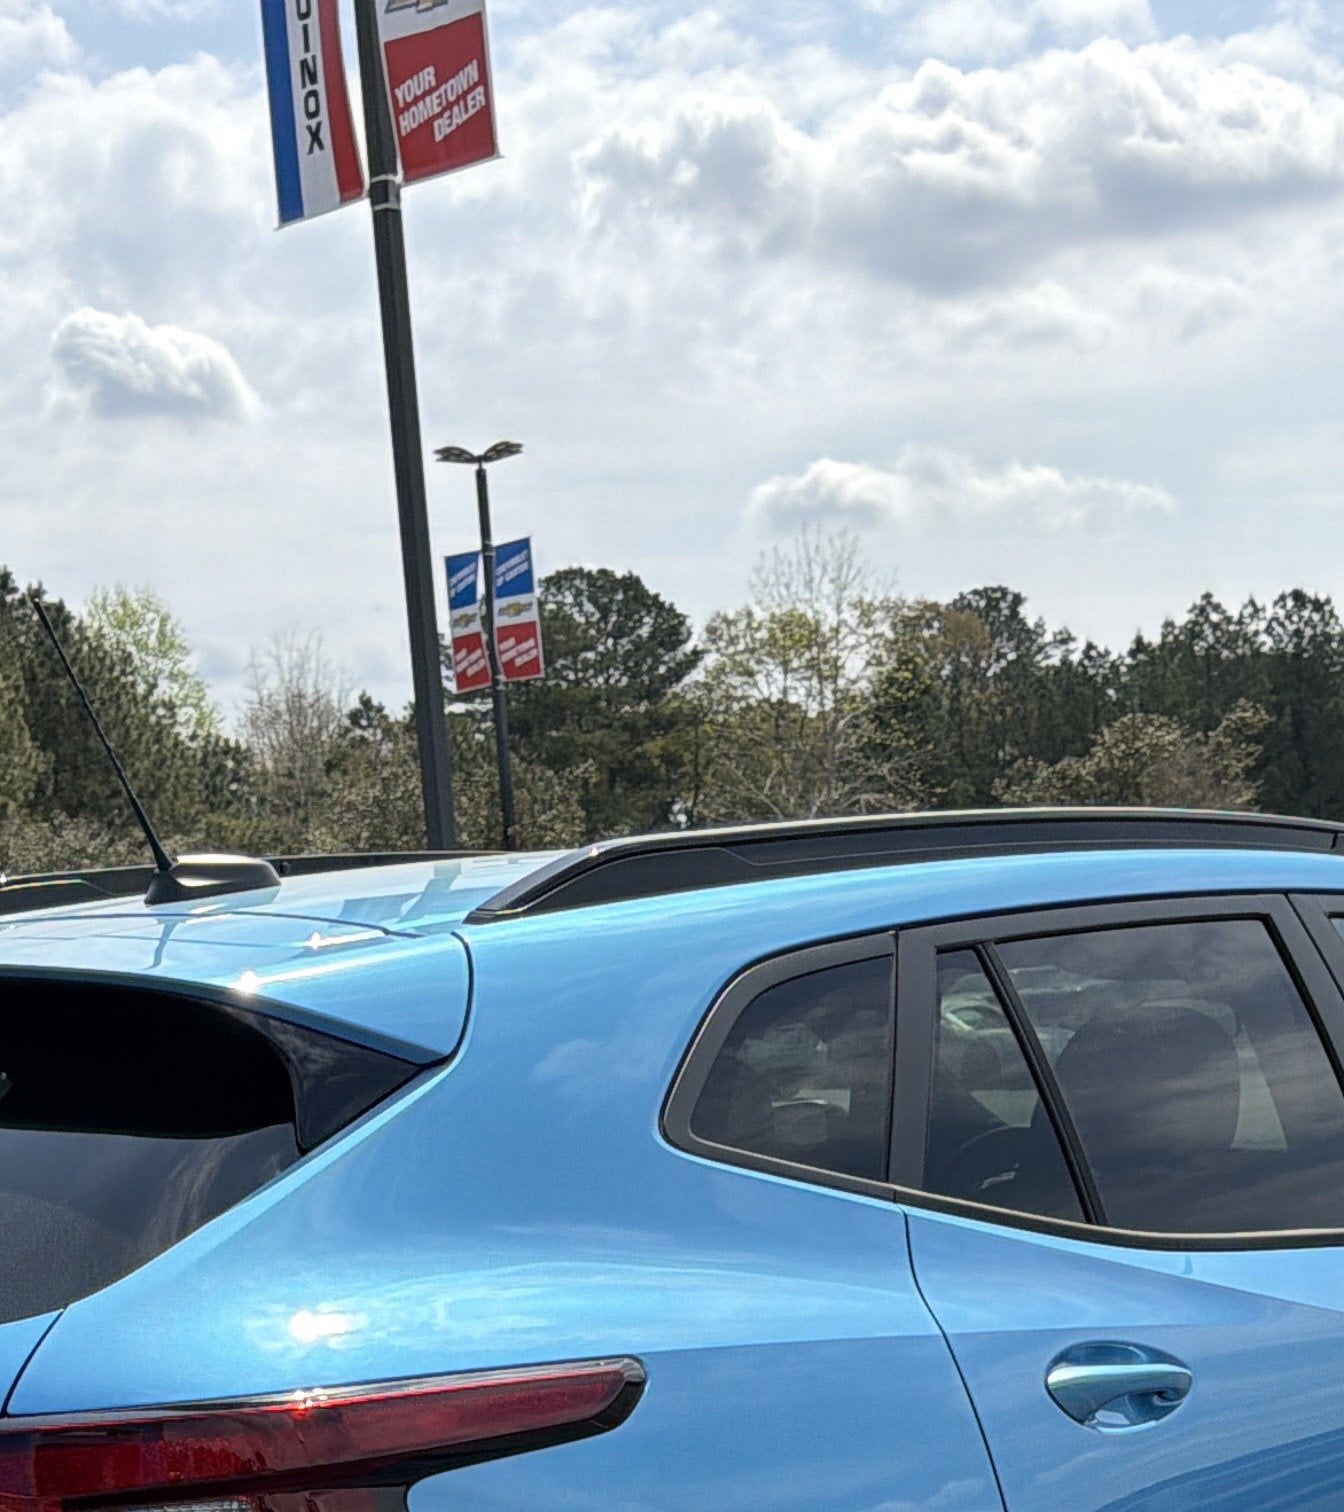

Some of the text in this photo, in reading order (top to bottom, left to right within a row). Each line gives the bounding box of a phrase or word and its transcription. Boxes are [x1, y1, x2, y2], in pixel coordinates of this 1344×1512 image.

[395, 65, 436, 108] YOUR
[399, 59, 479, 137] HOMETOWN
[433, 85, 486, 142] DEALER
